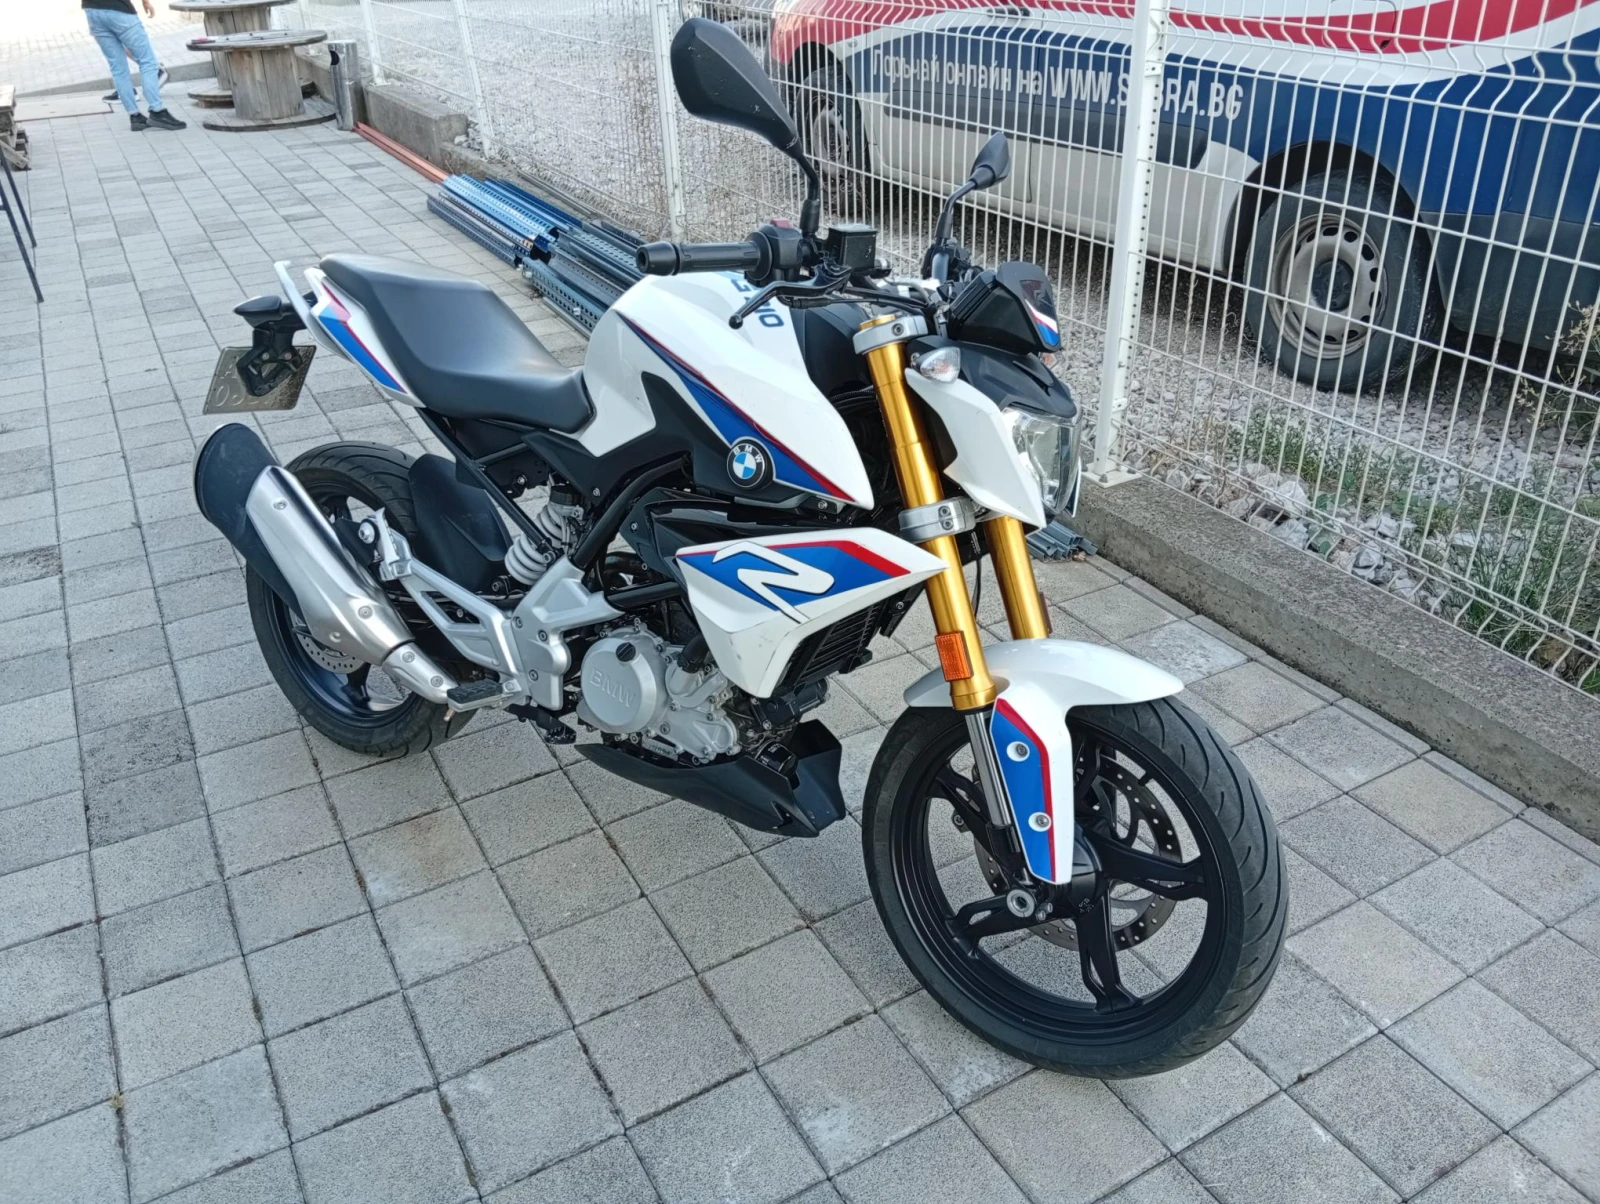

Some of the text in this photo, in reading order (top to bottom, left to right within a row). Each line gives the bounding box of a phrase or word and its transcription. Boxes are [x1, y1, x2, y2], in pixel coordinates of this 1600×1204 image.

[873, 50, 940, 83] Поръчай
[946, 60, 1012, 92] онлайн
[1019, 69, 1043, 96] на
[731, 279, 785, 328] G10
[733, 444, 763, 463] BMW
[589, 667, 636, 708] BMW
